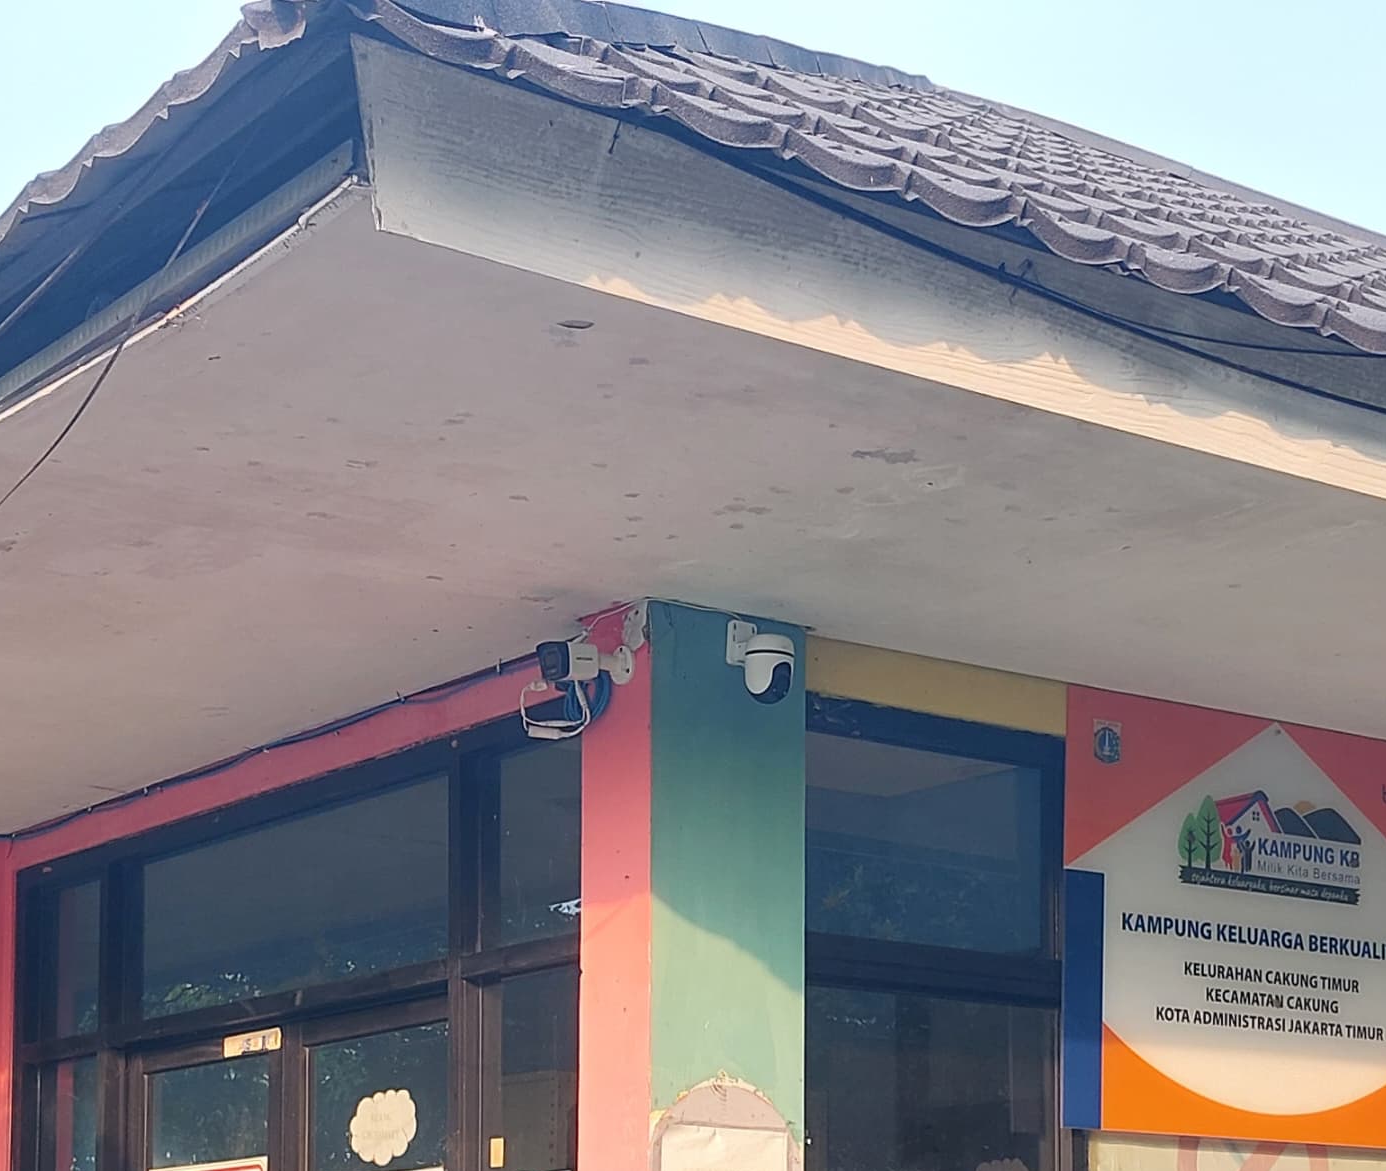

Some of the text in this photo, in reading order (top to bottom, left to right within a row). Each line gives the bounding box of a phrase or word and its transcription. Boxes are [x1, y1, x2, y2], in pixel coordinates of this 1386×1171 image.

[1258, 838, 1360, 868] KAMPUNG KB
[1257, 859, 1361, 884] Milik Kita Bersama
[1121, 912, 1213, 940] KAMPUNG
[1217, 923, 1305, 951] KELUARGA
[1184, 961, 1360, 993] KELURAHAN CAKUNG TIMUR
[1206, 987, 1339, 1014] KECAMATAN CAKUNG
[1156, 1006, 1384, 1041] KOTA ADMINISTRASI JAKARTA TIMUR
